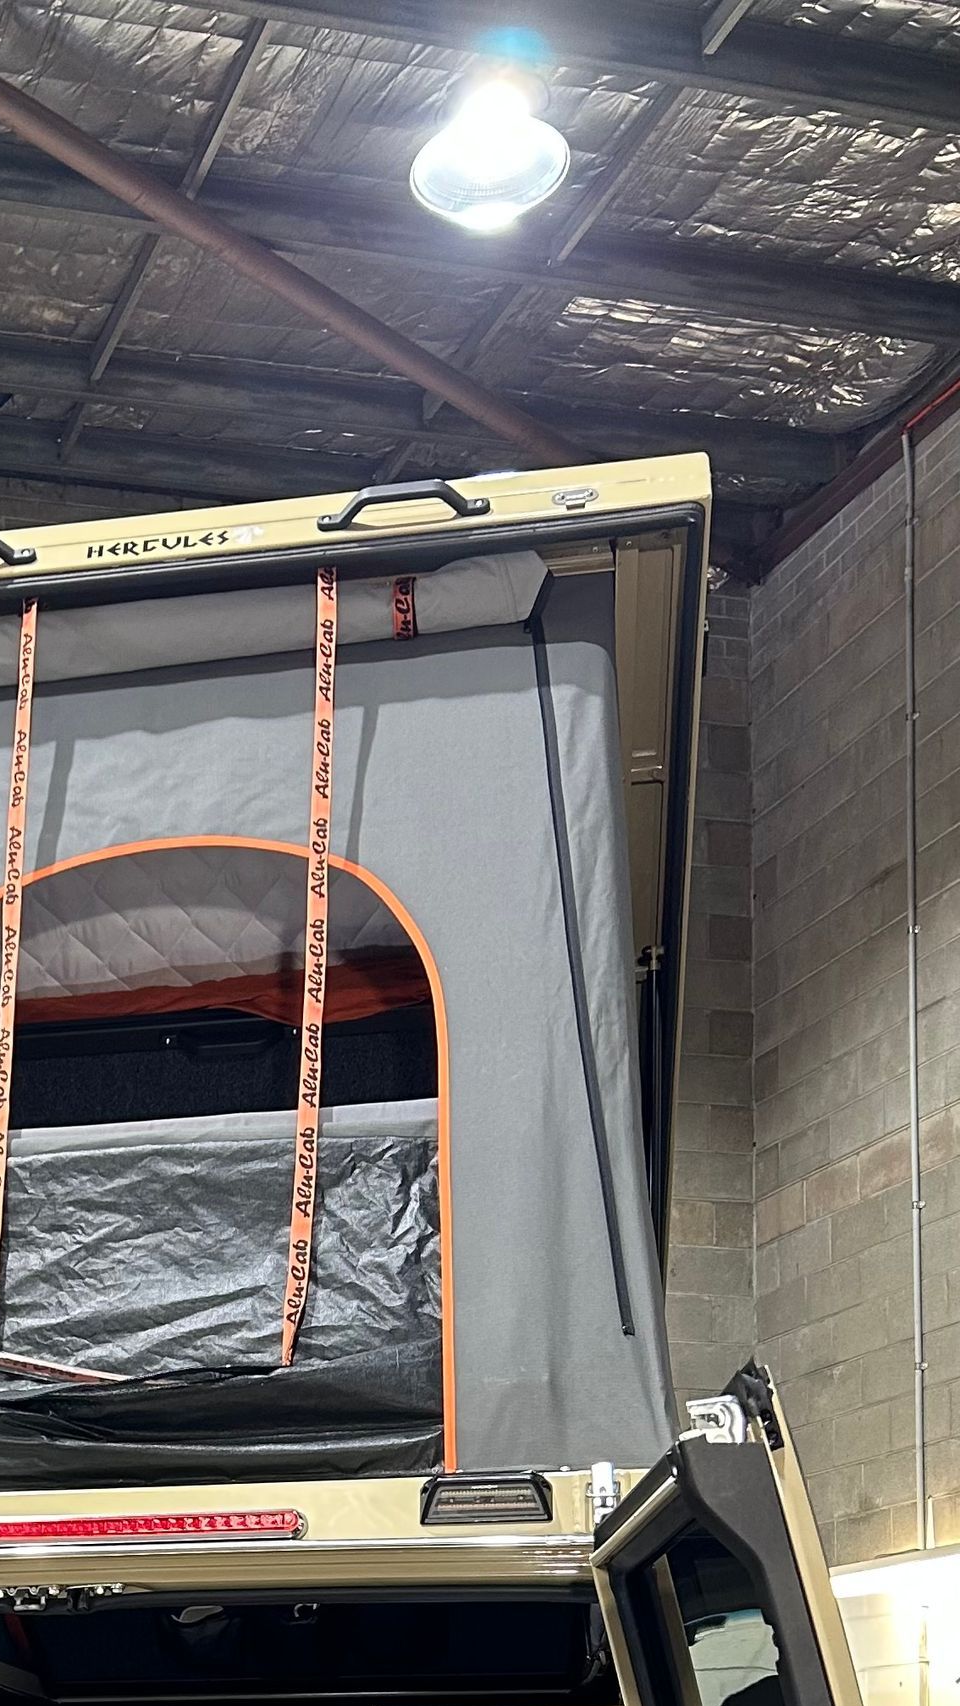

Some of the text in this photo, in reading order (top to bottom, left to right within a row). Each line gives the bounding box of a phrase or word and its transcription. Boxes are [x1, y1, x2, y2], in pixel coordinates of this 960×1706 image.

[87, 530, 230, 559] HERCULES
[19, 632, 33, 711] Alu-Cab
[318, 618, 335, 703] Alu-Cab
[12, 729, 27, 808] Alu-Cab
[314, 718, 332, 800] Alu-Cab
[5, 825, 22, 905] Alu-Cab
[311, 817, 328, 899] Alu-Cab
[0, 925, 17, 1008] Alu-Cab
[307, 918, 325, 1004] Alu-Cab
[300, 1022, 320, 1109] Alu-Cab
[295, 1126, 315, 1218] Alu-Cab
[286, 1238, 309, 1326] Alu-Cab
